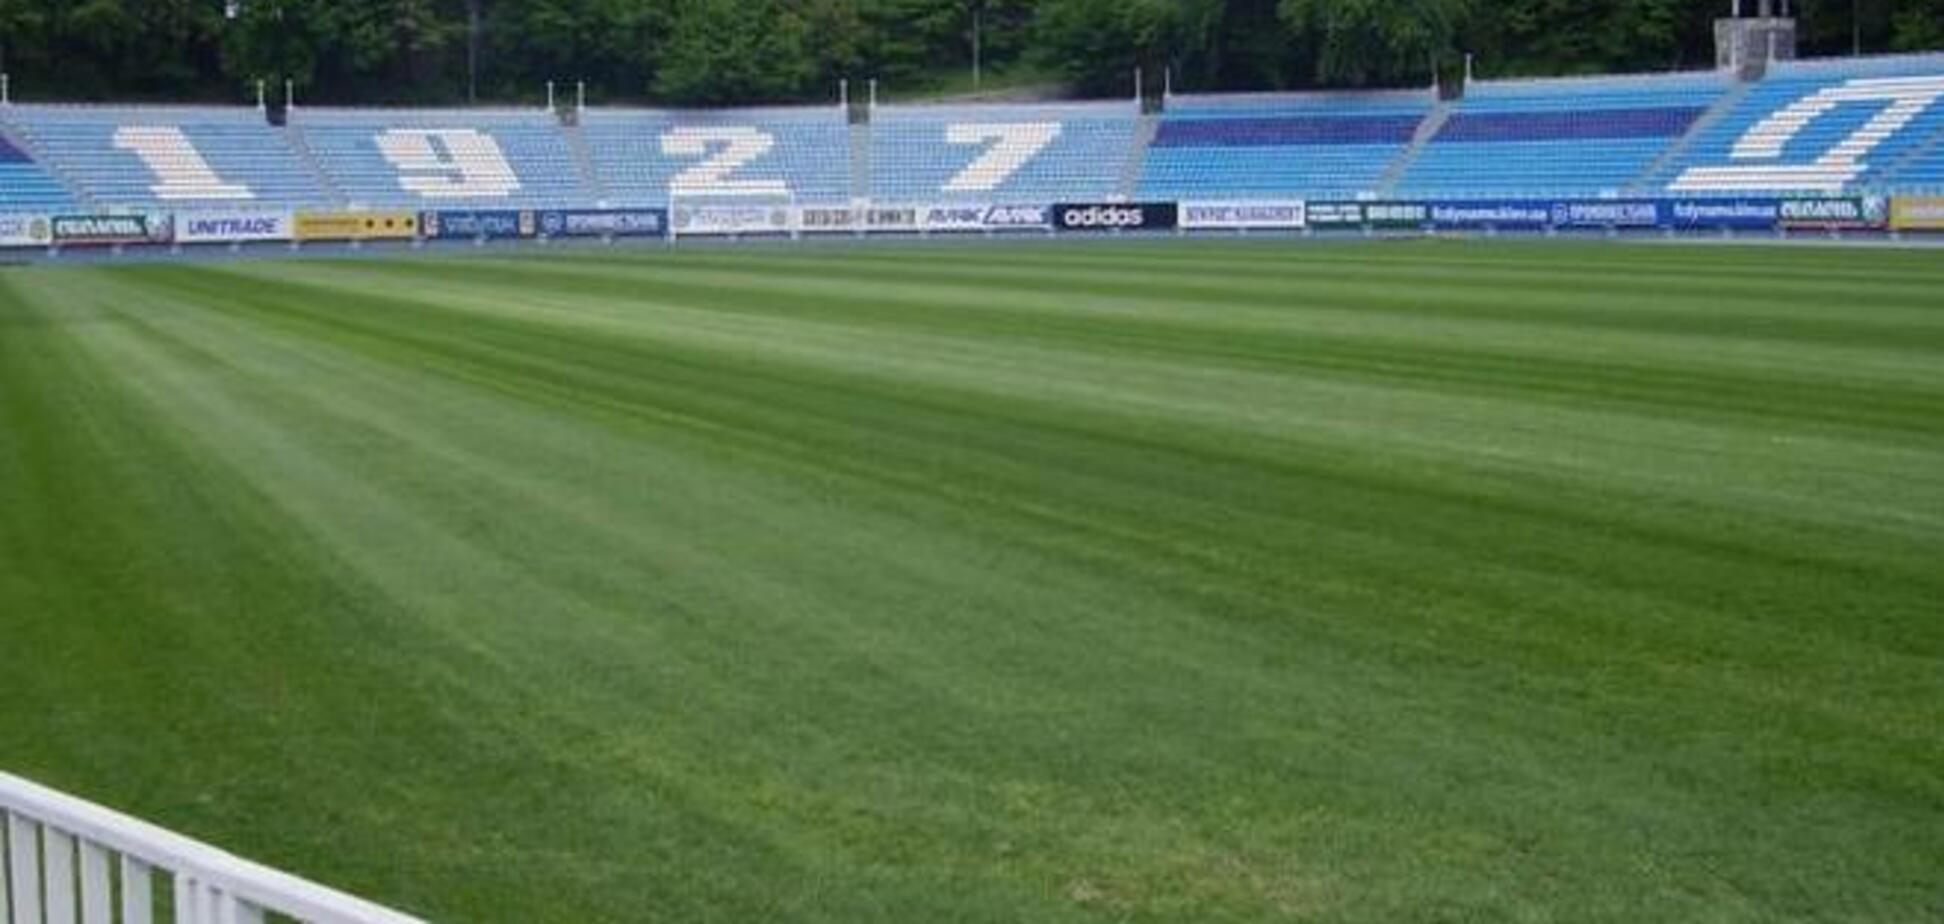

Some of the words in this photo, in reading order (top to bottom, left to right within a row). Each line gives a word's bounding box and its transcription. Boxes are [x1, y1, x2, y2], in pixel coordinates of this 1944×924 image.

[112, 126, 256, 199] 1
[374, 129, 521, 197] 9
[660, 126, 788, 195] 2
[942, 122, 1062, 193] 7
[1065, 206, 1143, 225] adidas
[188, 218, 282, 235] UNITRADE
